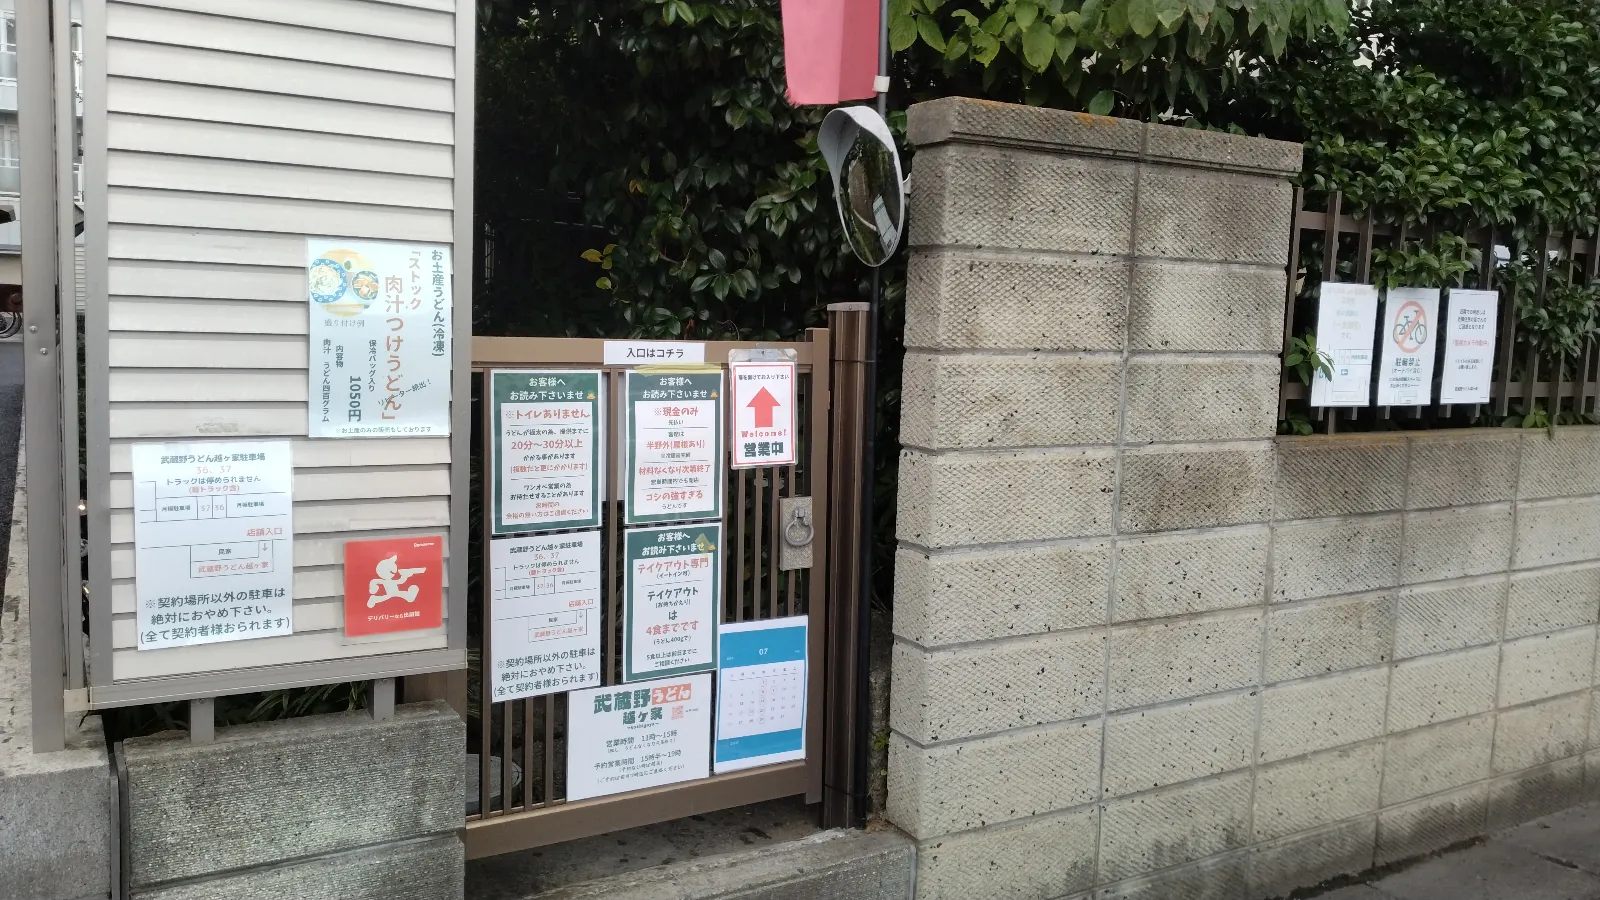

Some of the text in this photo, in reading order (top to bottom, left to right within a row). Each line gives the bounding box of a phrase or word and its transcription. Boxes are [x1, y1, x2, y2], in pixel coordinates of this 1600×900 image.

[431, 249, 445, 357] お土産うどん(冷凍)
[324, 319, 365, 328] 盛り付け例
[335, 344, 344, 368] 内容物
[626, 347, 685, 359] 入口はコチラ
[368, 339, 377, 392] 保冷バッグ入り
[528, 377, 566, 387] お客様へ
[659, 376, 692, 386] お客様へ
[348, 375, 362, 423] 1050円
[509, 390, 584, 401] お読み下さいませ
[642, 389, 708, 399] お読み下さいませ
[740, 428, 787, 438] Welcome!
[744, 441, 784, 458] 営業中
[166, 474, 262, 486] トラックは停められません
[646, 490, 703, 501] コシの強すぎる
[200, 504, 211, 512] 37
[214, 503, 225, 511] 36
[246, 527, 283, 537] 店舗入口
[657, 532, 691, 543] お客様へ
[641, 542, 705, 556] お読み下さいませ
[637, 558, 709, 574] テイクアウト専門
[647, 587, 699, 602] テイクアウト
[151, 604, 272, 625] 絶対におやめ下さい。
[668, 611, 678, 621] は
[645, 620, 699, 636] 4食までです
[758, 647, 769, 656] 07
[593, 686, 691, 714] 武蔵野 うどん
[622, 706, 663, 726] 越ヶ家
[605, 736, 635, 748] 営業時間
